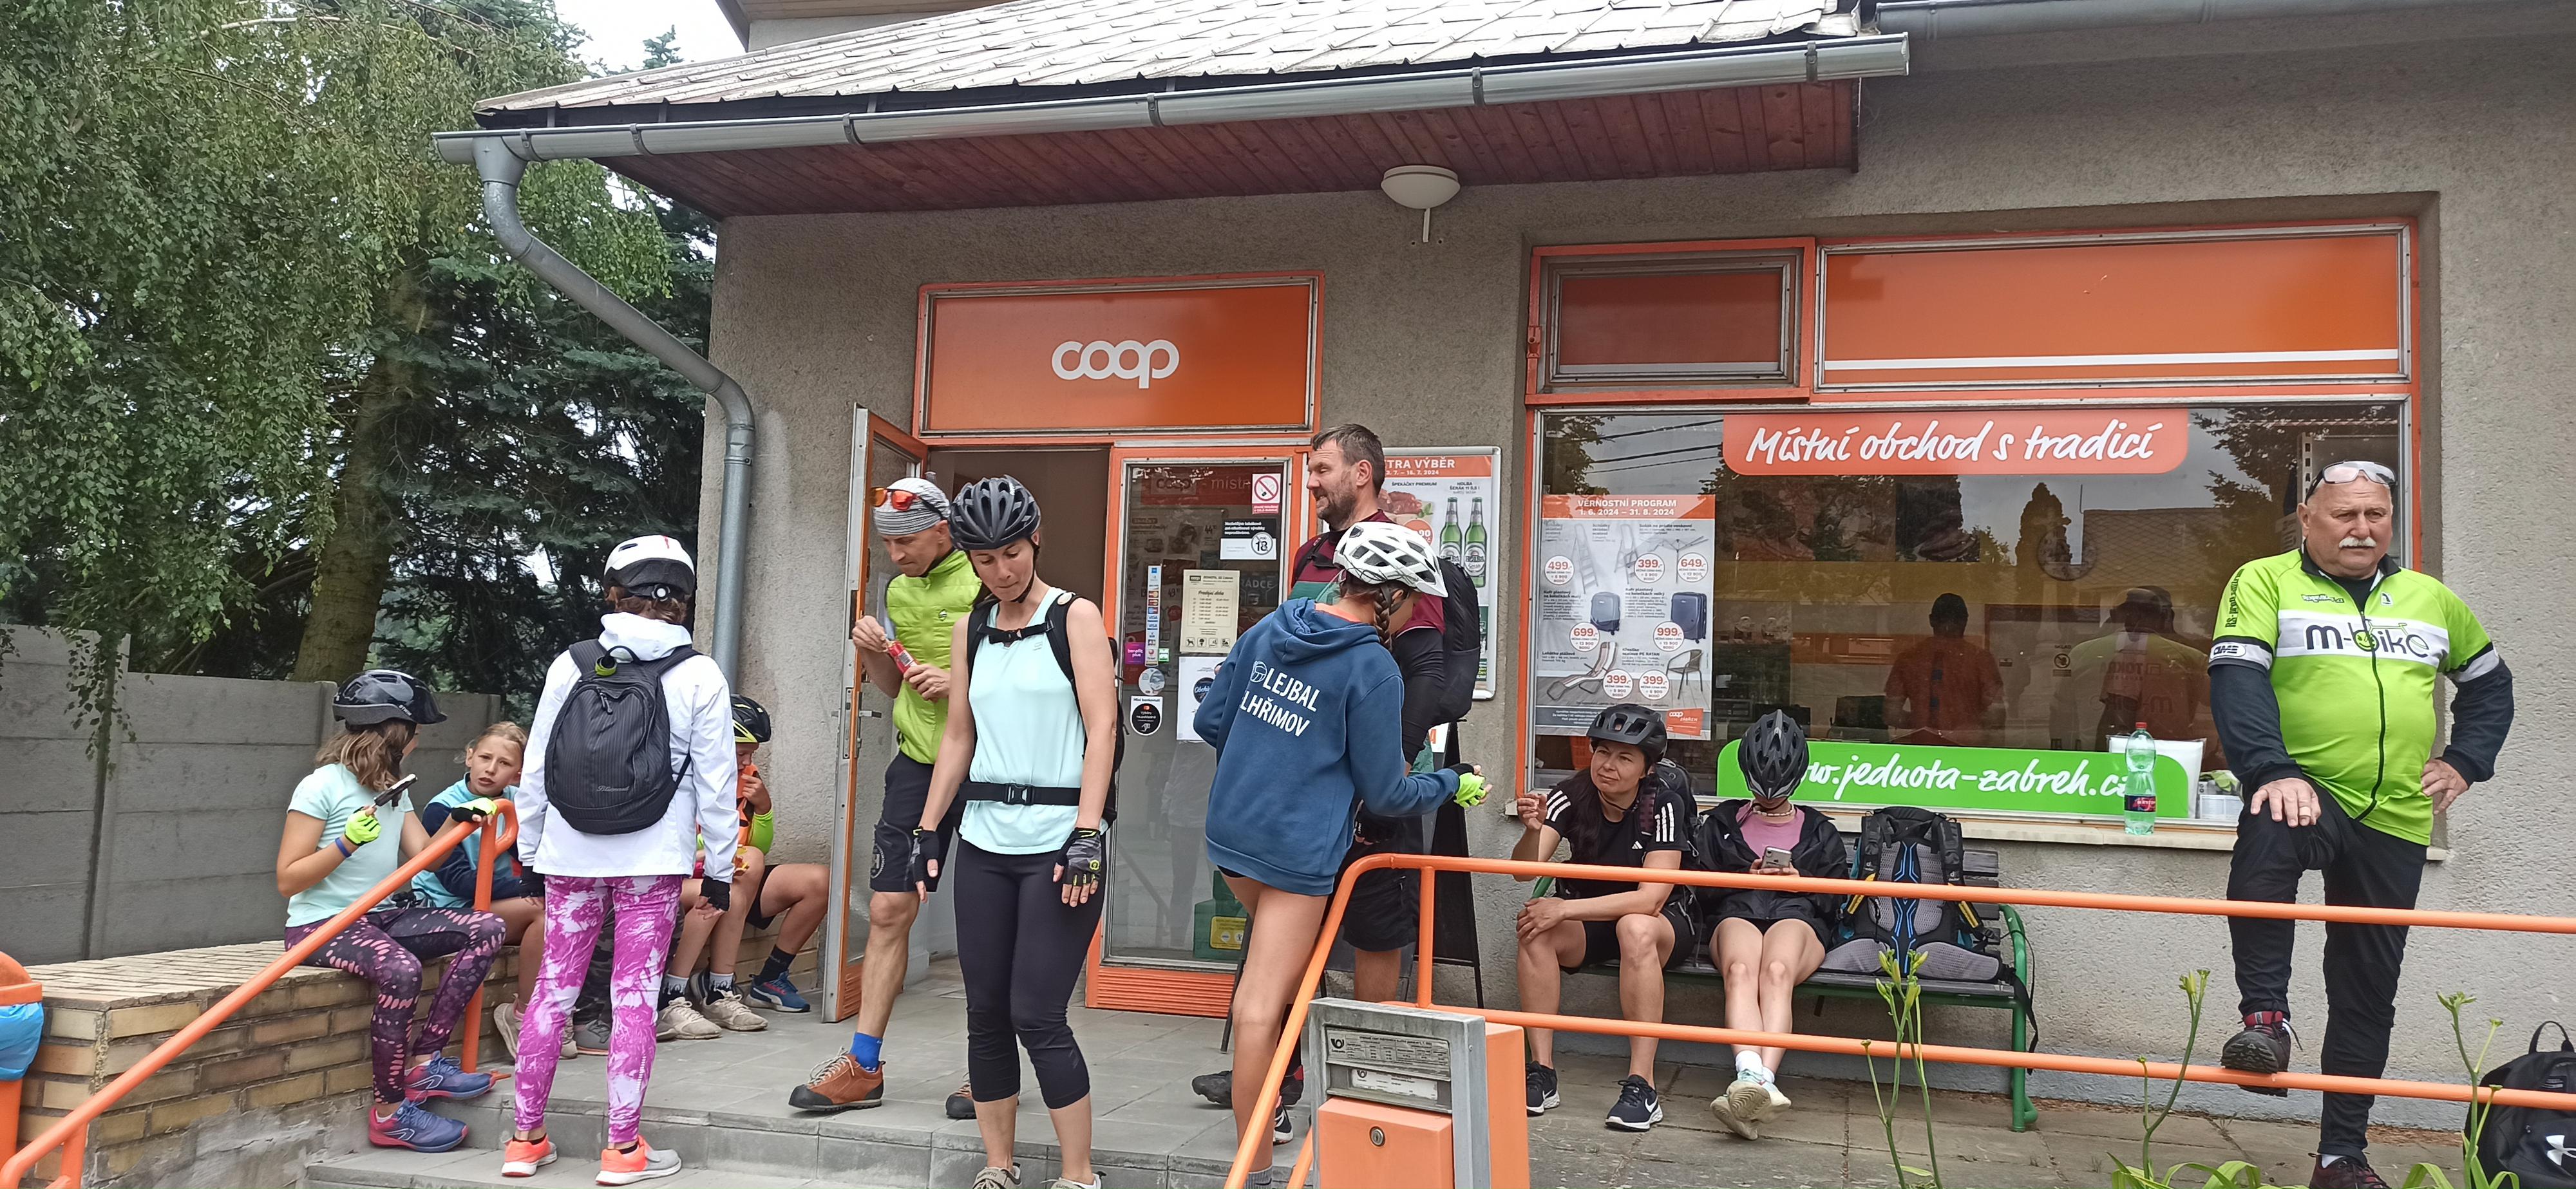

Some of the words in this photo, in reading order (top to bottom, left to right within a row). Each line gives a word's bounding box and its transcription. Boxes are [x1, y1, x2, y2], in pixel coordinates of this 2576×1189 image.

[1052, 339, 1180, 389] coop
[1745, 426, 1860, 464] Místní
[1860, 420, 1994, 462] obchod
[1992, 433, 2015, 461] s
[2023, 418, 2164, 461] tradicí
[1385, 460, 1411, 469] TRA
[1415, 456, 1455, 468] VÝBĚR
[1578, 498, 1629, 507] VĚRNOSTNÍ
[1255, 541, 1267, 551] 18
[1638, 559, 1662, 568] 399,-
[1681, 559, 1706, 567] 649,-
[1574, 628, 1598, 637] 699,-
[1657, 628, 1682, 636] 999,-
[1643, 676, 1667, 684] 399,-
[1239, 690, 1311, 737] LHŘIMOV
